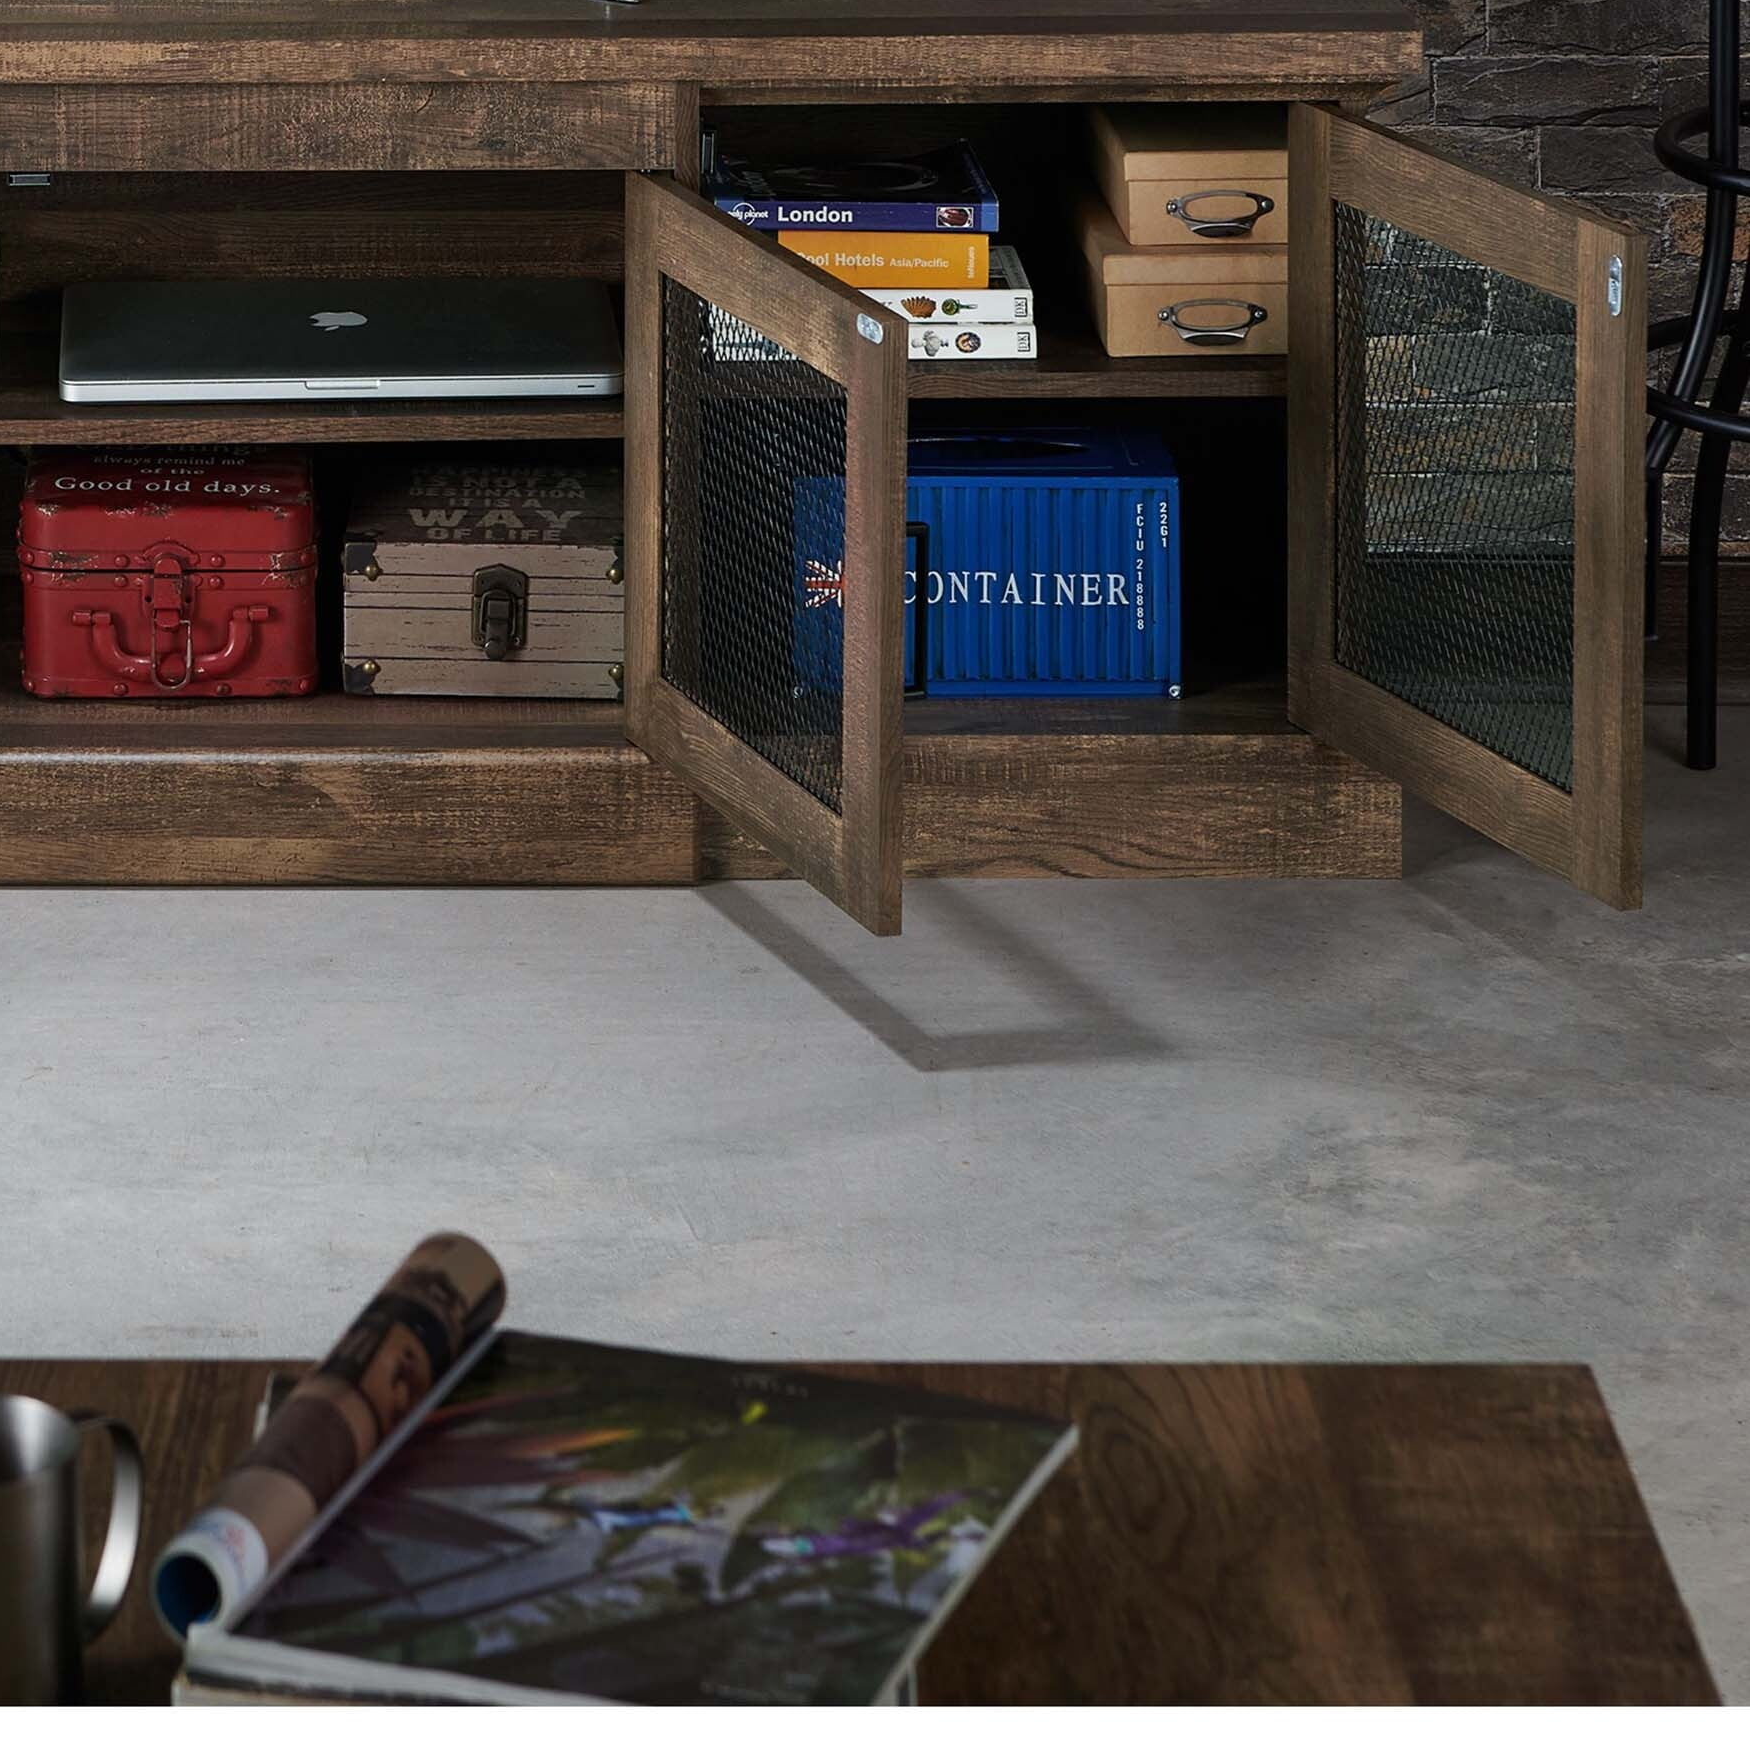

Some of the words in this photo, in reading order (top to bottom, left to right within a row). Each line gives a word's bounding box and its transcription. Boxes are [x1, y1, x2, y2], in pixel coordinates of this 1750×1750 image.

[778, 206, 853, 222] London
[797, 252, 829, 267] ool
[835, 253, 885, 267] Hotels
[890, 257, 949, 268] Asia/Pacific
[157, 456, 215, 466] remind
[222, 458, 245, 466] me
[54, 477, 133, 491] Good
[145, 479, 191, 492] old
[203, 480, 280, 497] days.
[409, 488, 585, 499] DESTINATION
[484, 499, 511, 508] IS
[522, 499, 543, 508] A
[408, 509, 583, 529] WAY
[1136, 503, 1145, 551] FCIU
[426, 528, 473, 540] OF
[484, 529, 562, 541] LIFE
[1136, 558, 1145, 630] 218888
